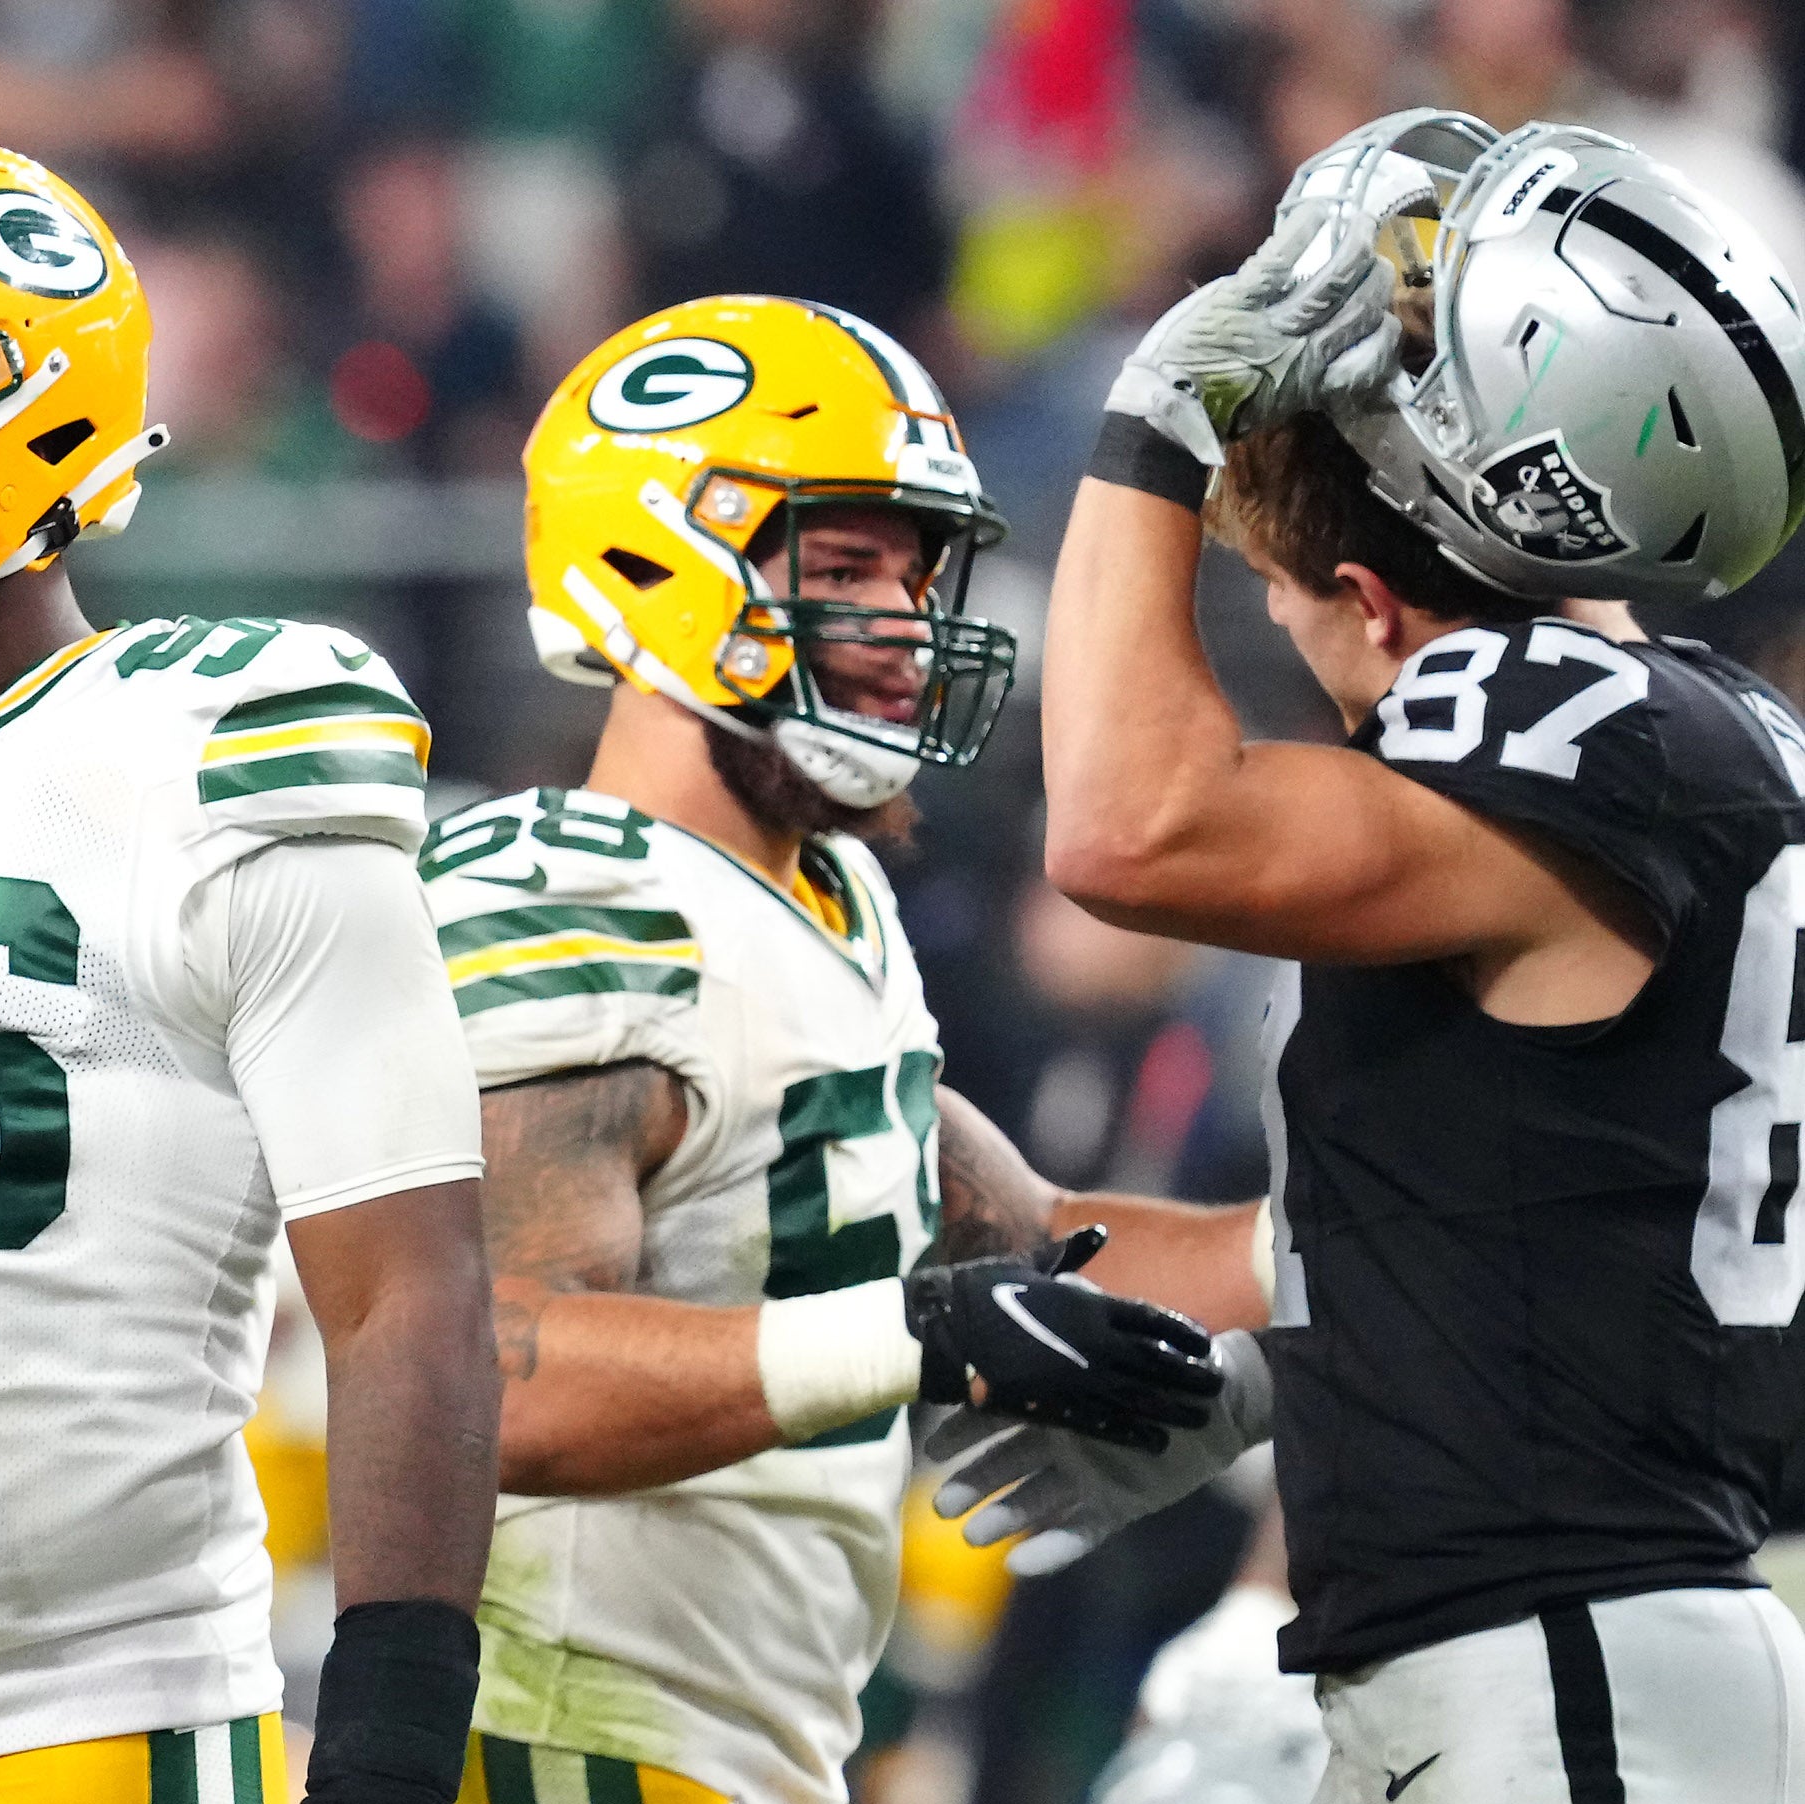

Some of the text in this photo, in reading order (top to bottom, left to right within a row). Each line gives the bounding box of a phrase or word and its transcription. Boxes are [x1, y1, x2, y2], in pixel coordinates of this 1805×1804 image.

[589, 336, 754, 432] G
[1377, 626, 1650, 781] 87
[417, 787, 654, 883] 58
